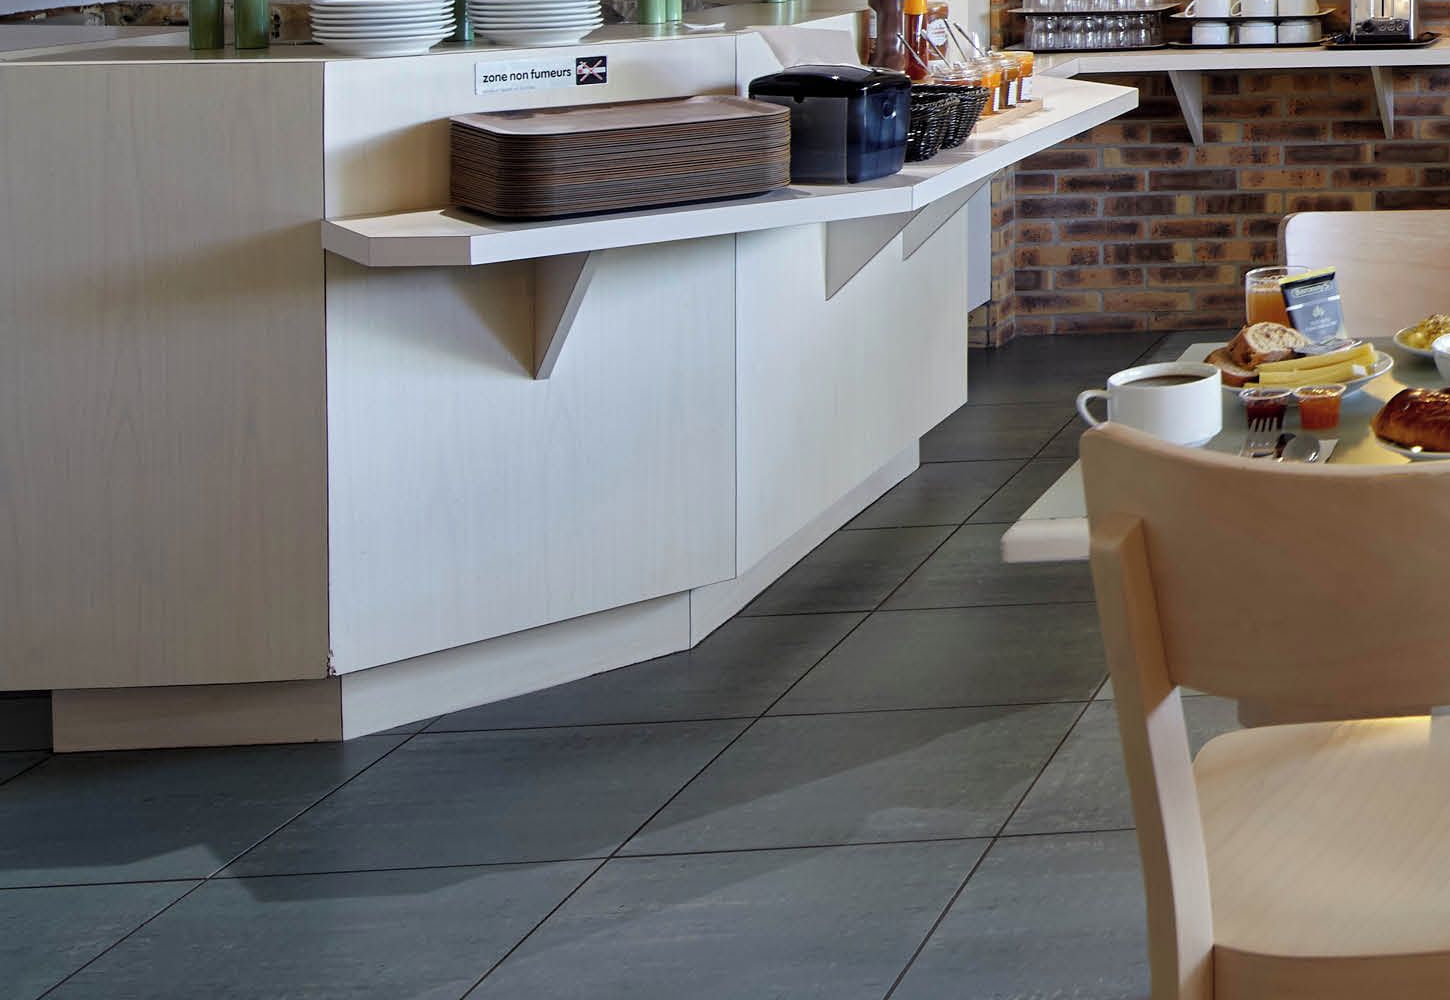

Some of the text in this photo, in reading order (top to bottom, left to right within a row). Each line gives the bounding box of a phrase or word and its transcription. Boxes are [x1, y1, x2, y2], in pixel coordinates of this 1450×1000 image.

[483, 68, 572, 83] zone non fumeurs
